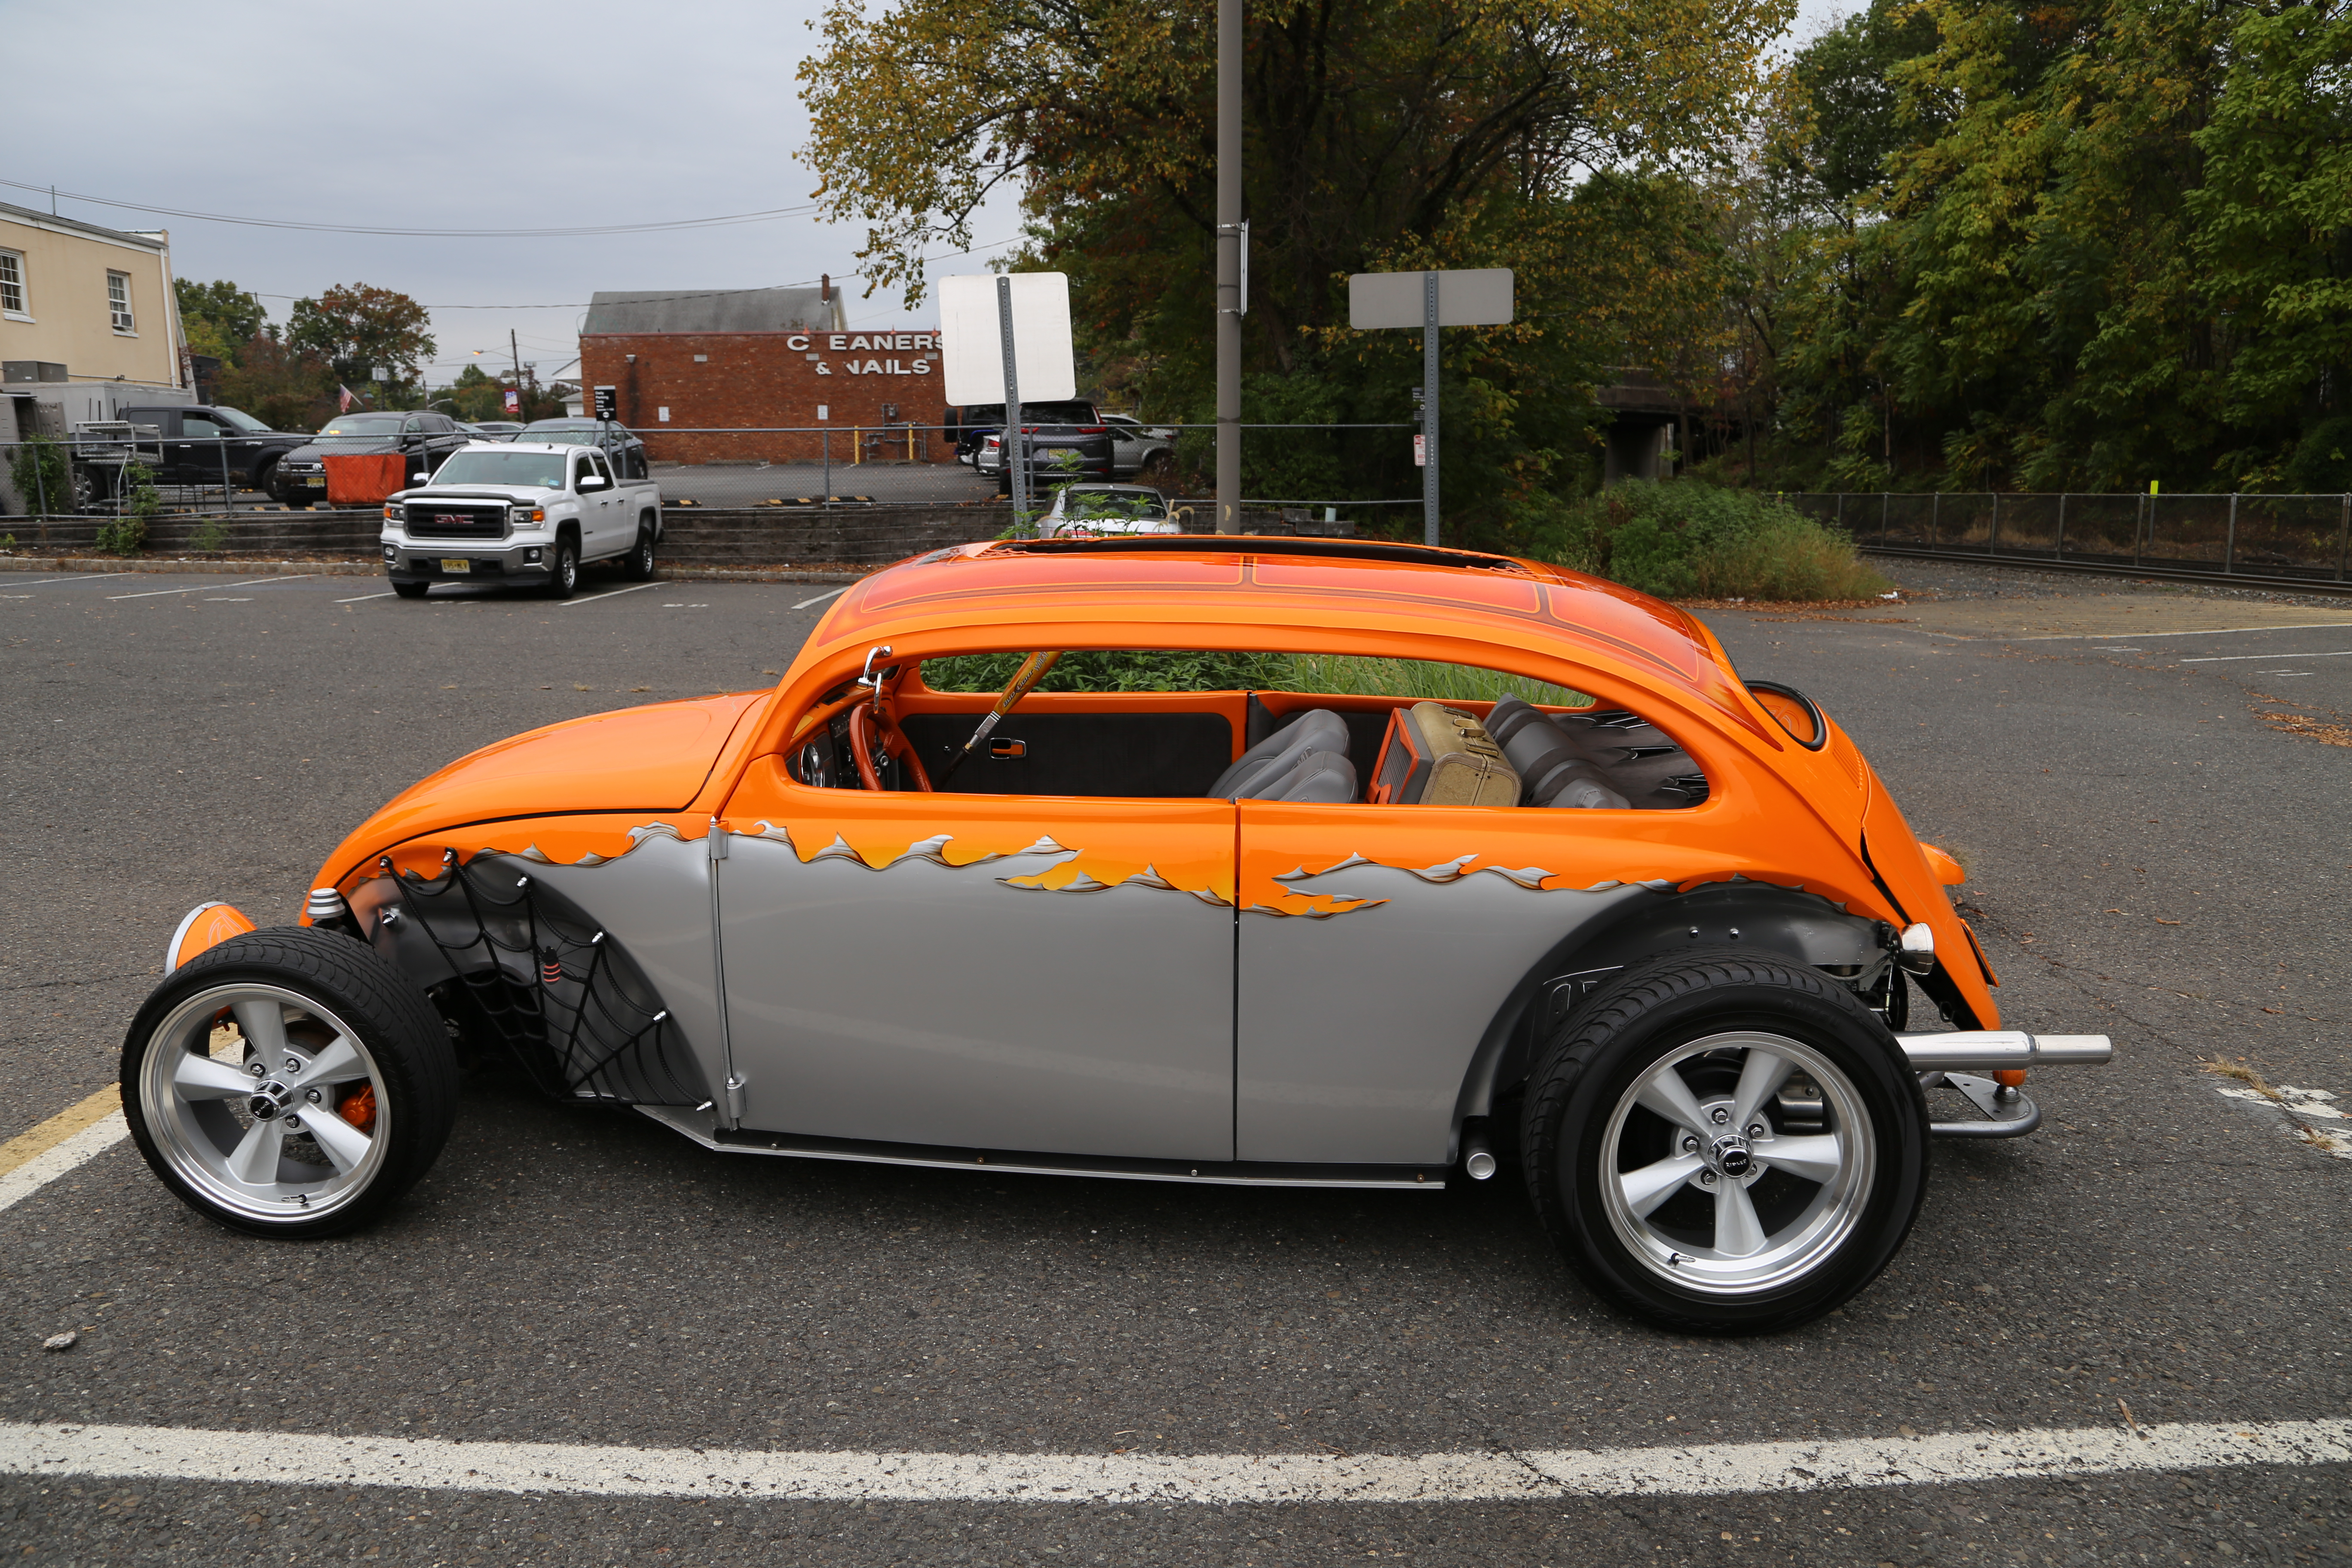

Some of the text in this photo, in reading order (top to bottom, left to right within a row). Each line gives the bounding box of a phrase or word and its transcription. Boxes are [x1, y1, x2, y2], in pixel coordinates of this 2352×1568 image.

[815, 362, 832, 375] &
[435, 514, 474, 524] GMC
[1003, 669, 1033, 707] BUD LIGHT
